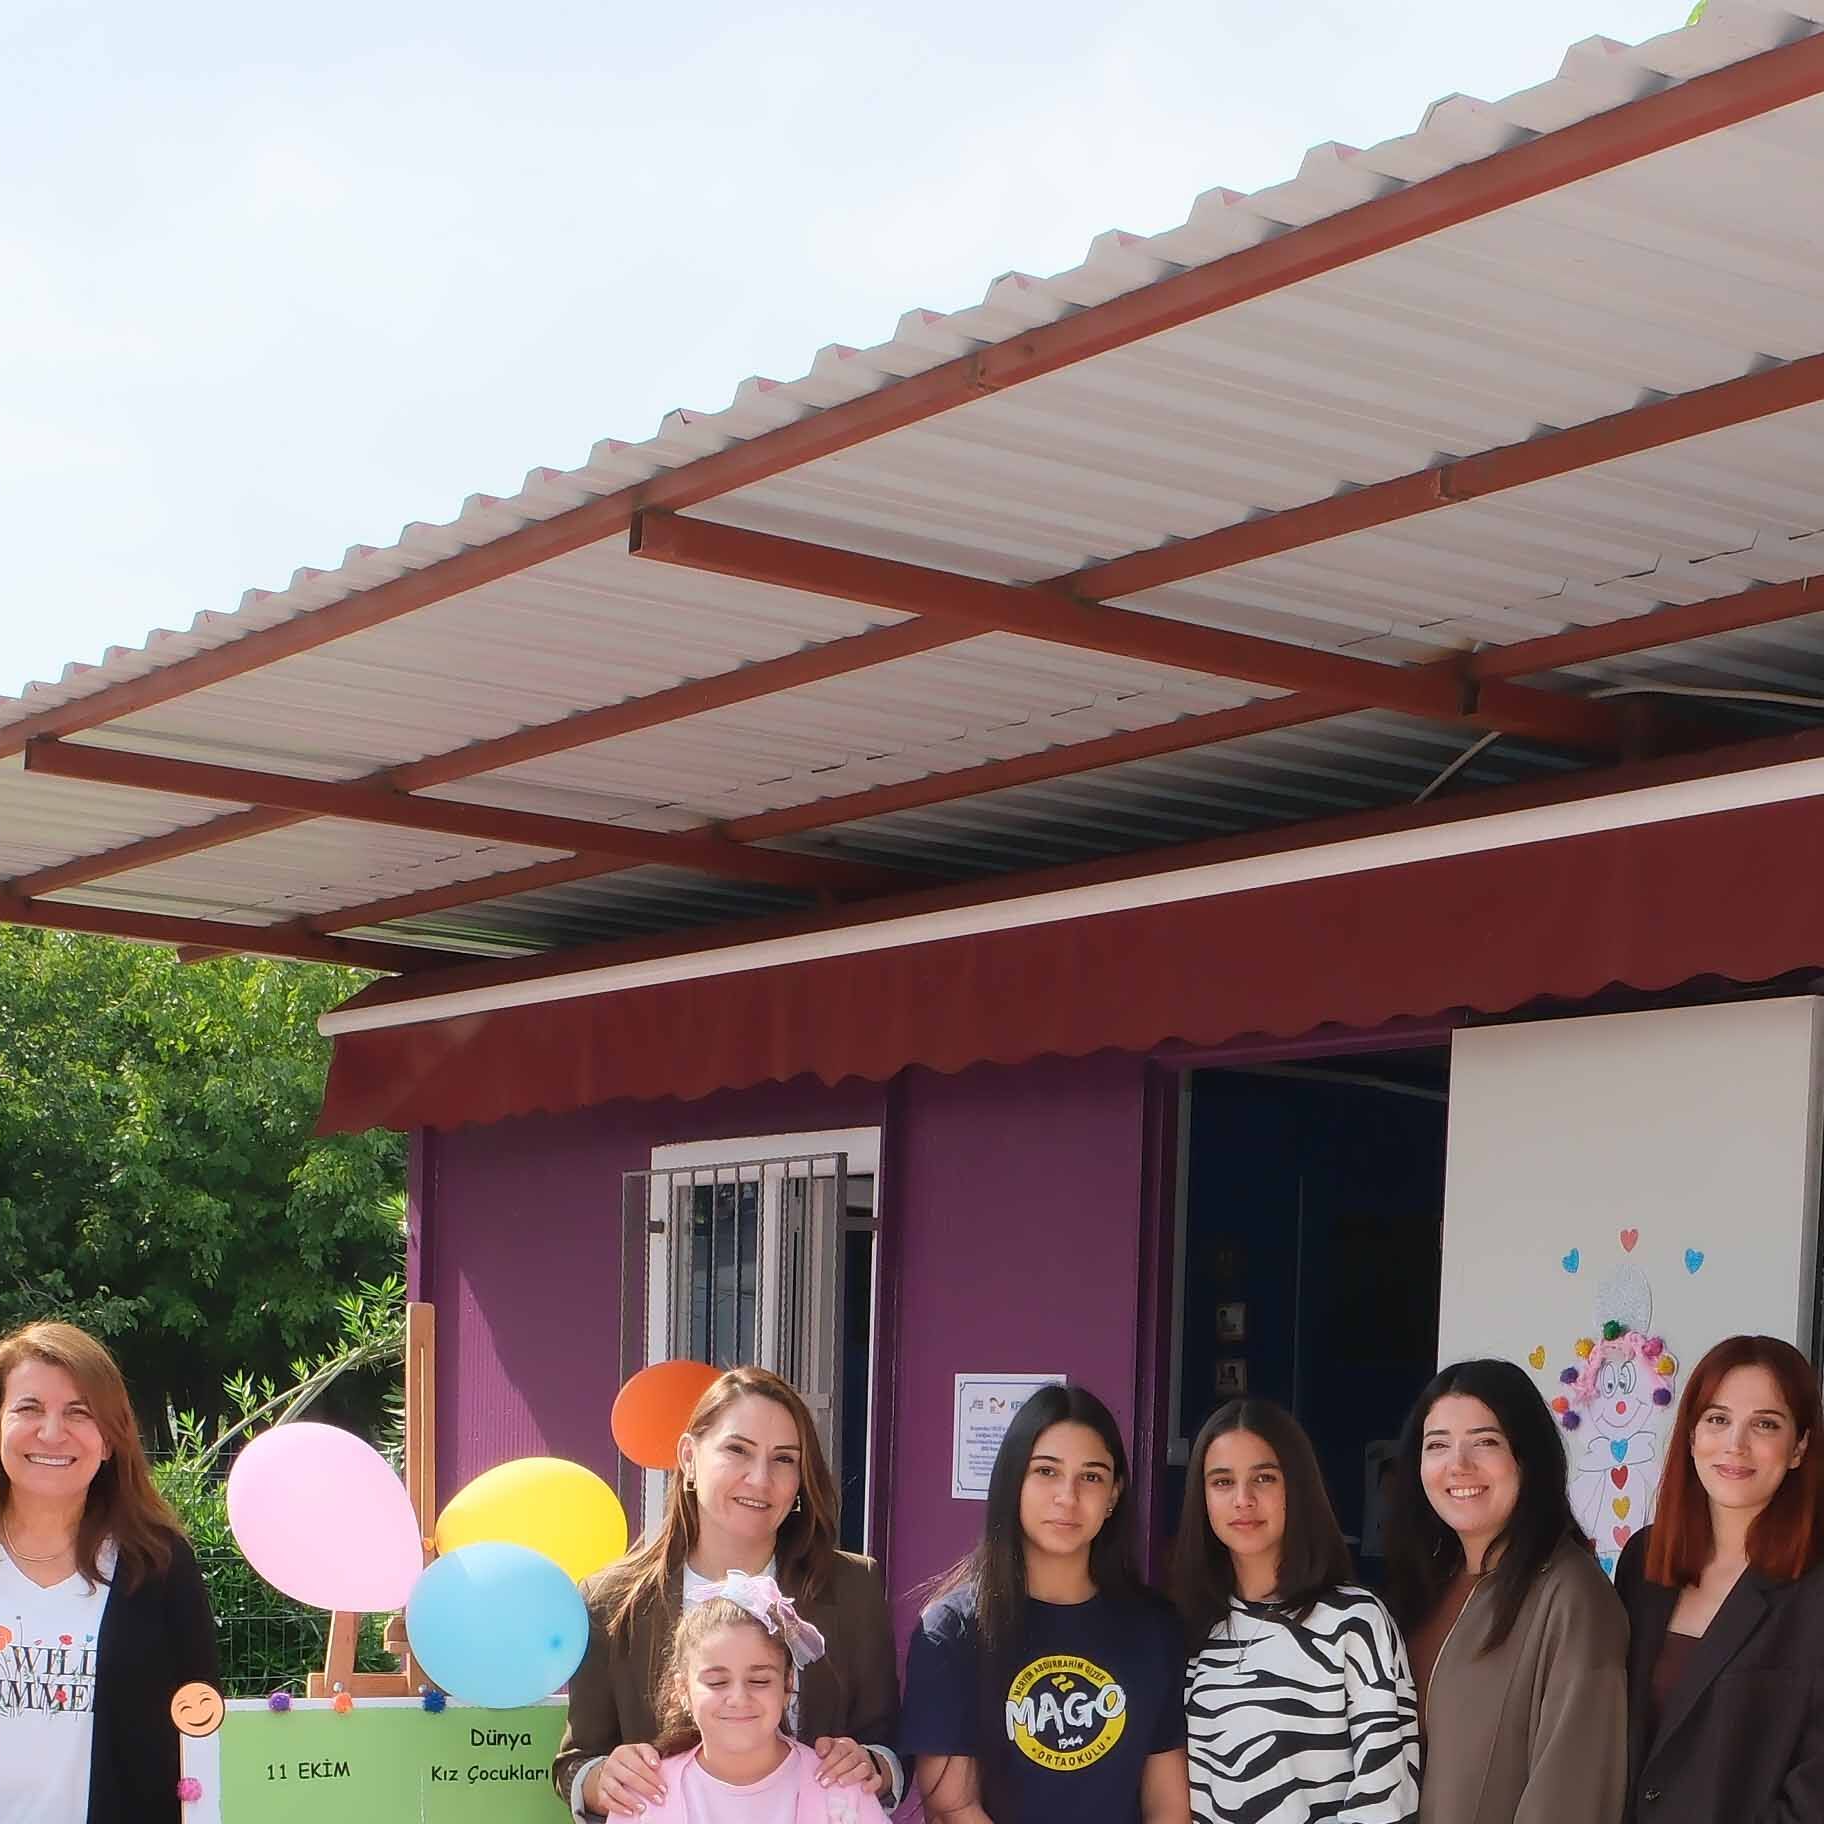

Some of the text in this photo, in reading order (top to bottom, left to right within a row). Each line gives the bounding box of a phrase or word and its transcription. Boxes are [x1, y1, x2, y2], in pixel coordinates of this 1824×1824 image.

[1005, 1683, 1127, 1741] MAGO
[470, 1728, 532, 1751] Dünya
[1037, 1742, 1107, 1767] ORTAOKULU
[267, 1758, 351, 1780] 11 EKİM
[431, 1764, 550, 1784] Kız Çocukları
